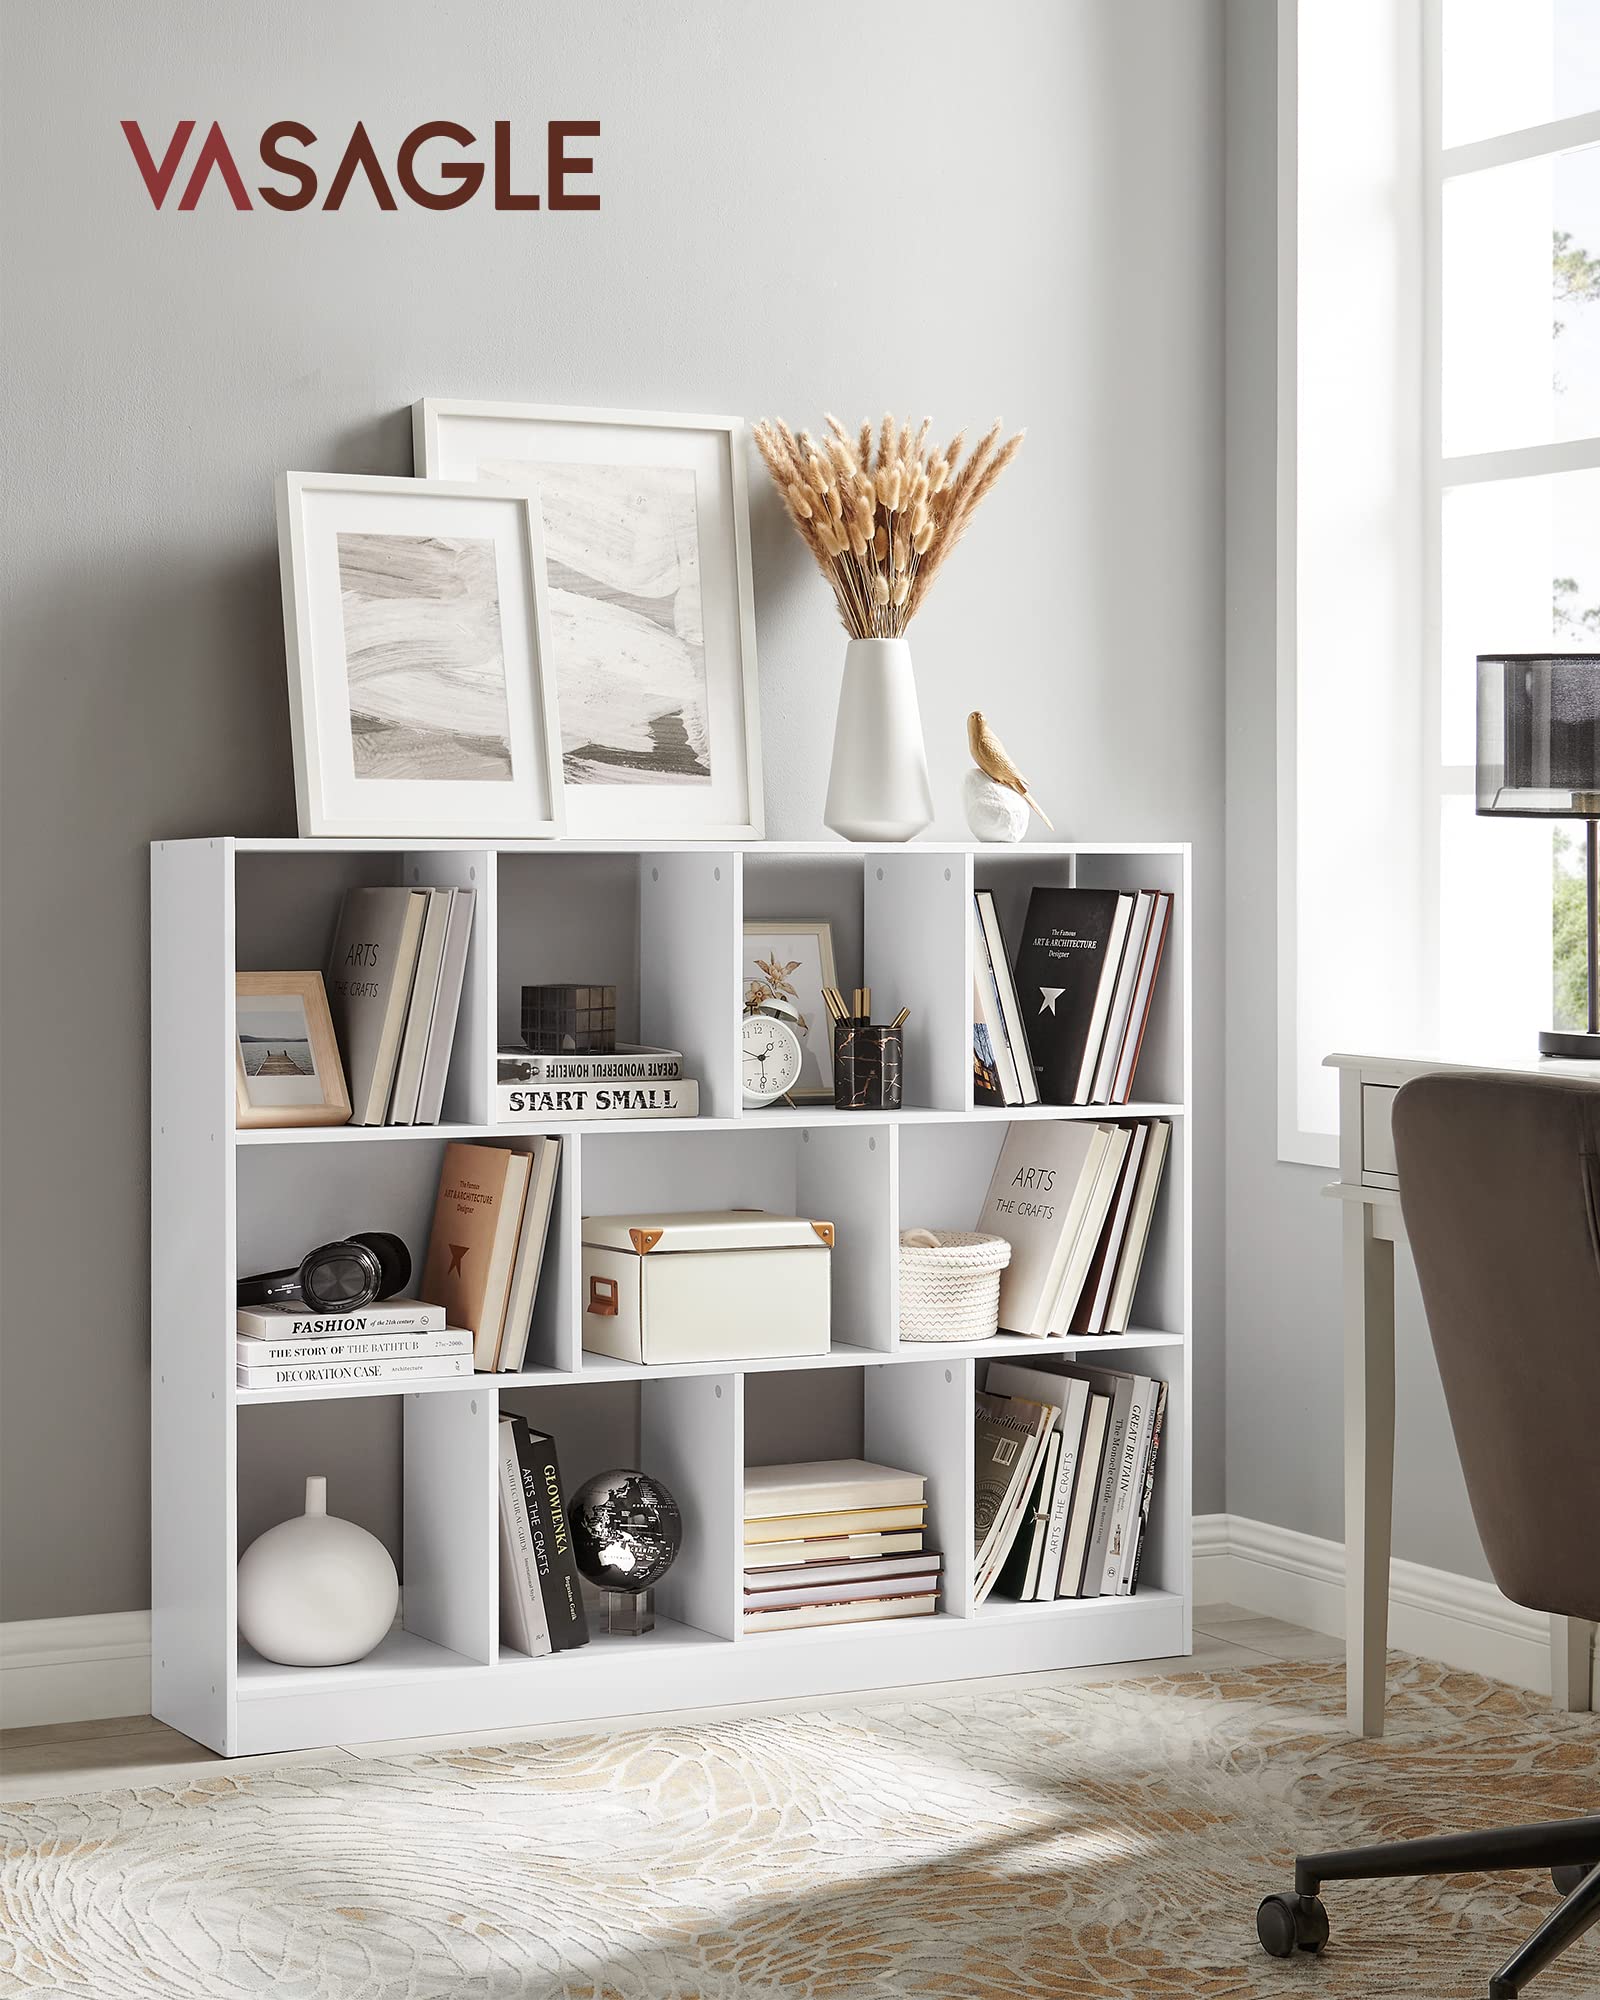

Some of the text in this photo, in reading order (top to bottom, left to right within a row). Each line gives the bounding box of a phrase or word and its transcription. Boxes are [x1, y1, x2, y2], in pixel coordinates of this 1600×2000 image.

[344, 943, 380, 967] ARTS
[1048, 950, 1070, 960] Designer
[1050, 939, 1098, 950] ARCHITECTURE
[349, 982, 379, 998] CRAFTS
[753, 1026, 763, 1035] 12
[783, 1053, 789, 1061] 3
[545, 1061, 679, 1078] CREATE WONDERFUL HOMELIFE
[509, 1089, 679, 1112] START SMALL
[1011, 1166, 1057, 1191] ARTS
[995, 1198, 1055, 1220] THE CRAFTS
[291, 1318, 367, 1335] FASHION
[269, 1348, 292, 1359] THE
[294, 1346, 328, 1358] STORY
[330, 1345, 345, 1355] OF
[347, 1344, 369, 1355] THE
[371, 1341, 419, 1354] BATHTUB
[276, 1366, 352, 1383] DECORATION
[353, 1365, 382, 1379] CASE
[1113, 1418, 1124, 1436] The
[1127, 1404, 1142, 1444] GREAT
[1107, 1438, 1121, 1476] Monocle
[1120, 1444, 1135, 1492] BRITAIN
[1103, 1476, 1114, 1504] Guide
[505, 1458, 523, 1526] ARCHITECTURAL
[517, 1526, 529, 1553] GUIDE
[1049, 1452, 1074, 1555] ARTS THE CRAFTS
[521, 1468, 550, 1576] ARTS THE CRAFTS
